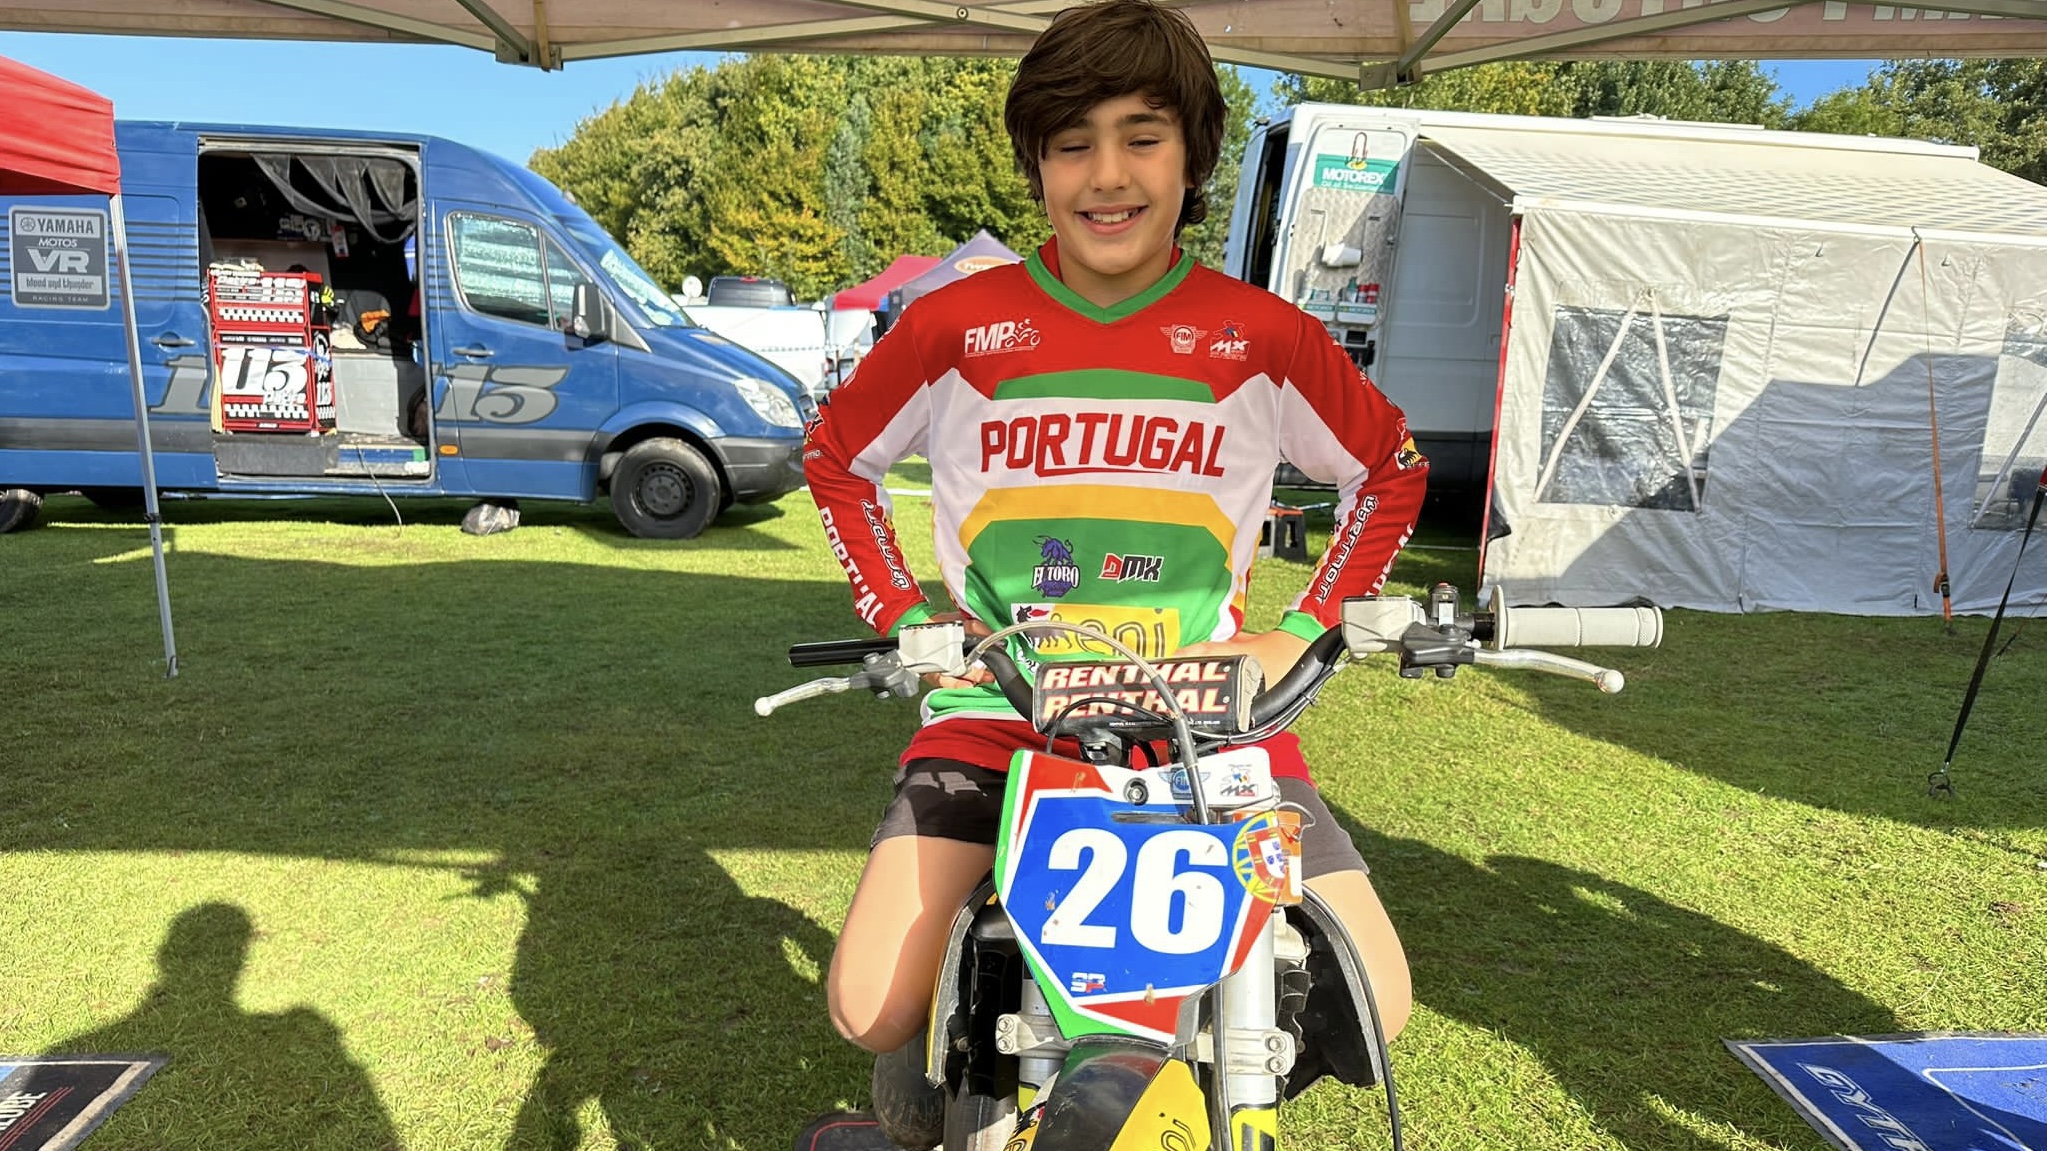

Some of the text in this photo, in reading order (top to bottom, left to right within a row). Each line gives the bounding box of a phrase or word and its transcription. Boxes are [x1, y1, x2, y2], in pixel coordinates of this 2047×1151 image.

[1322, 167, 1385, 184] MOTOREX
[37, 218, 94, 234] YAMAHA
[38, 238, 78, 247] MOTOS
[27, 248, 90, 273] VR
[965, 321, 1016, 353] FMP
[1210, 340, 1250, 354] MX
[980, 412, 1226, 478] PORTUGAL
[1047, 566, 1080, 588] TORO
[1100, 553, 1164, 583] DMX
[1041, 661, 1227, 690] RENTHAL
[1041, 687, 1227, 722] RENTHAL
[1041, 828, 1229, 955] 26
